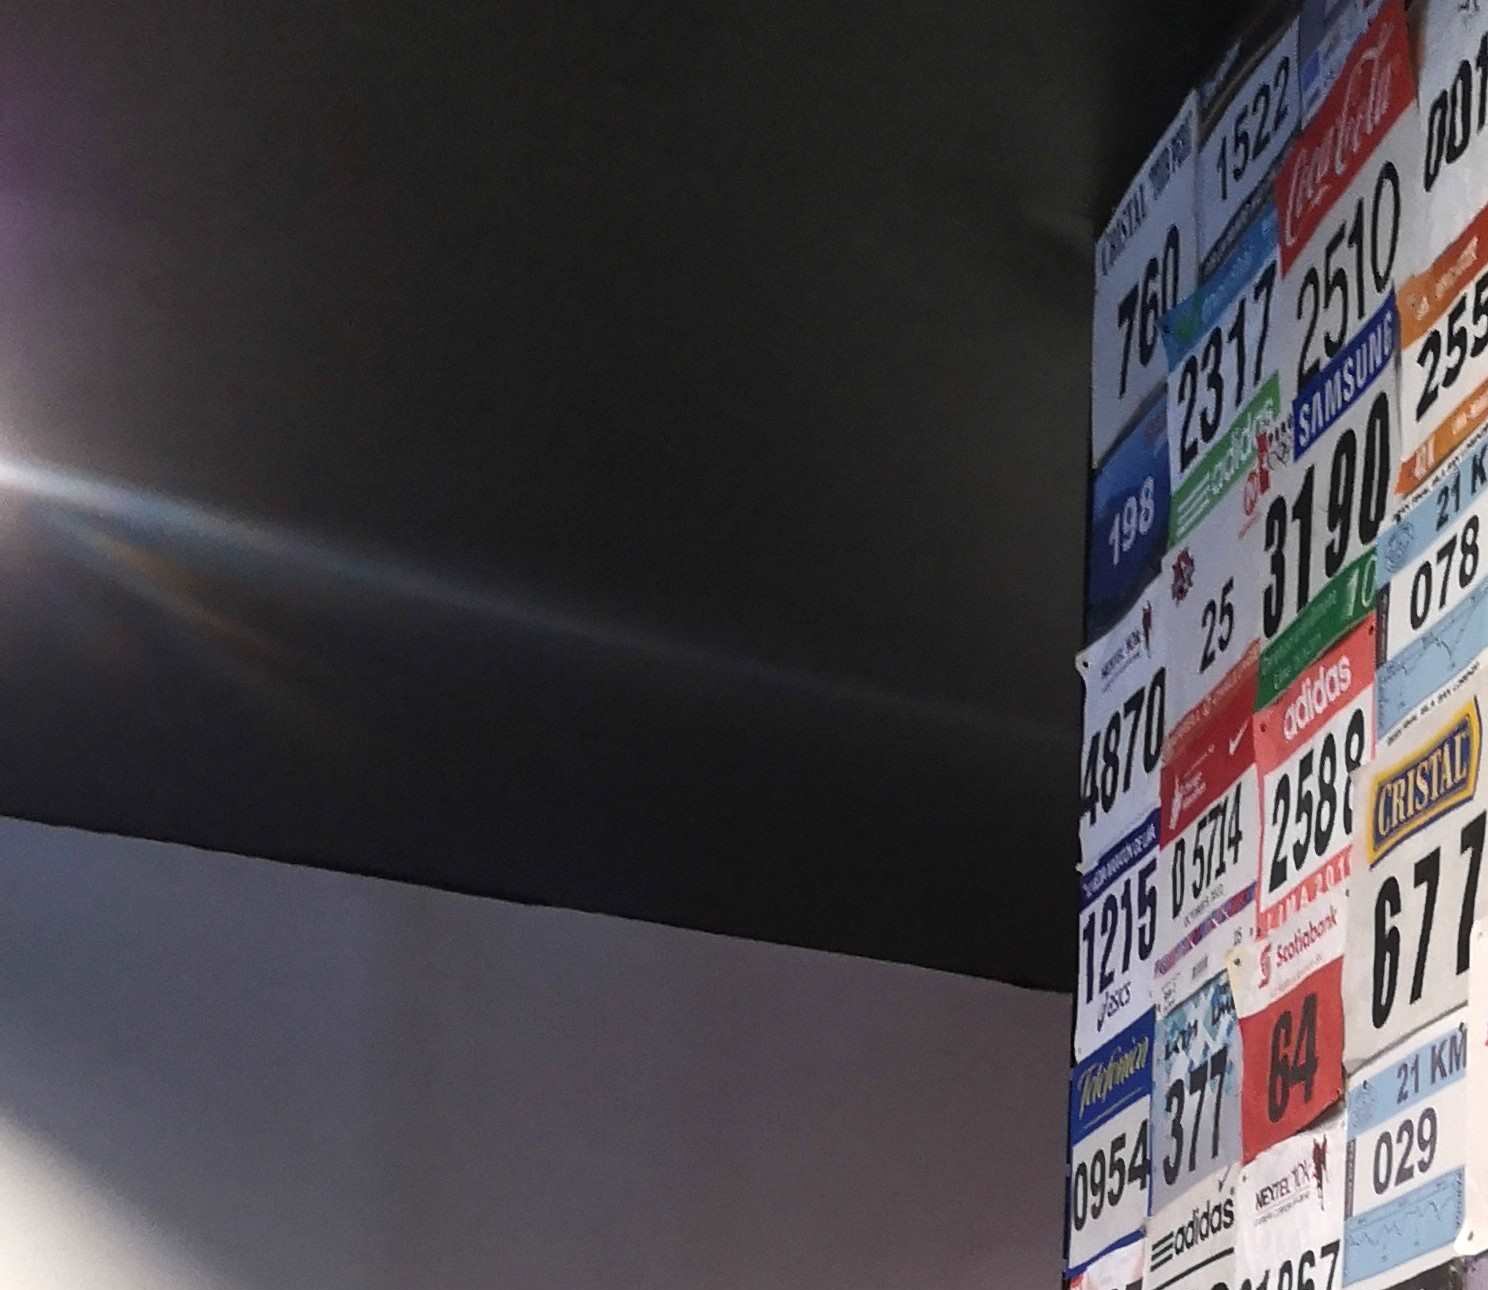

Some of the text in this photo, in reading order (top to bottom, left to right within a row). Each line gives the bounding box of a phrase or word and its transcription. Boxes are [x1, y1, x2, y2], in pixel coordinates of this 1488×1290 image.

[1216, 56, 1290, 199] 1522
[1297, 161, 1401, 381] 2510
[1177, 262, 1277, 473] 2317
[1298, 319, 1396, 448] SAMSUNG
[1110, 476, 1154, 565] 198
[1264, 393, 1391, 640] 3190
[1409, 514, 1481, 632] 078
[1282, 655, 1351, 742] adidas
[1376, 721, 1472, 836] CRISTAL
[1375, 808, 1487, 1030] 677
[1163, 1047, 1229, 1187] 377
[1267, 992, 1318, 1124] 64
[1396, 1024, 1467, 1104] 21 KM
[1073, 1119, 1149, 1232] 0954
[1373, 1106, 1439, 1196] 029
[1174, 1197, 1235, 1256] adidas
